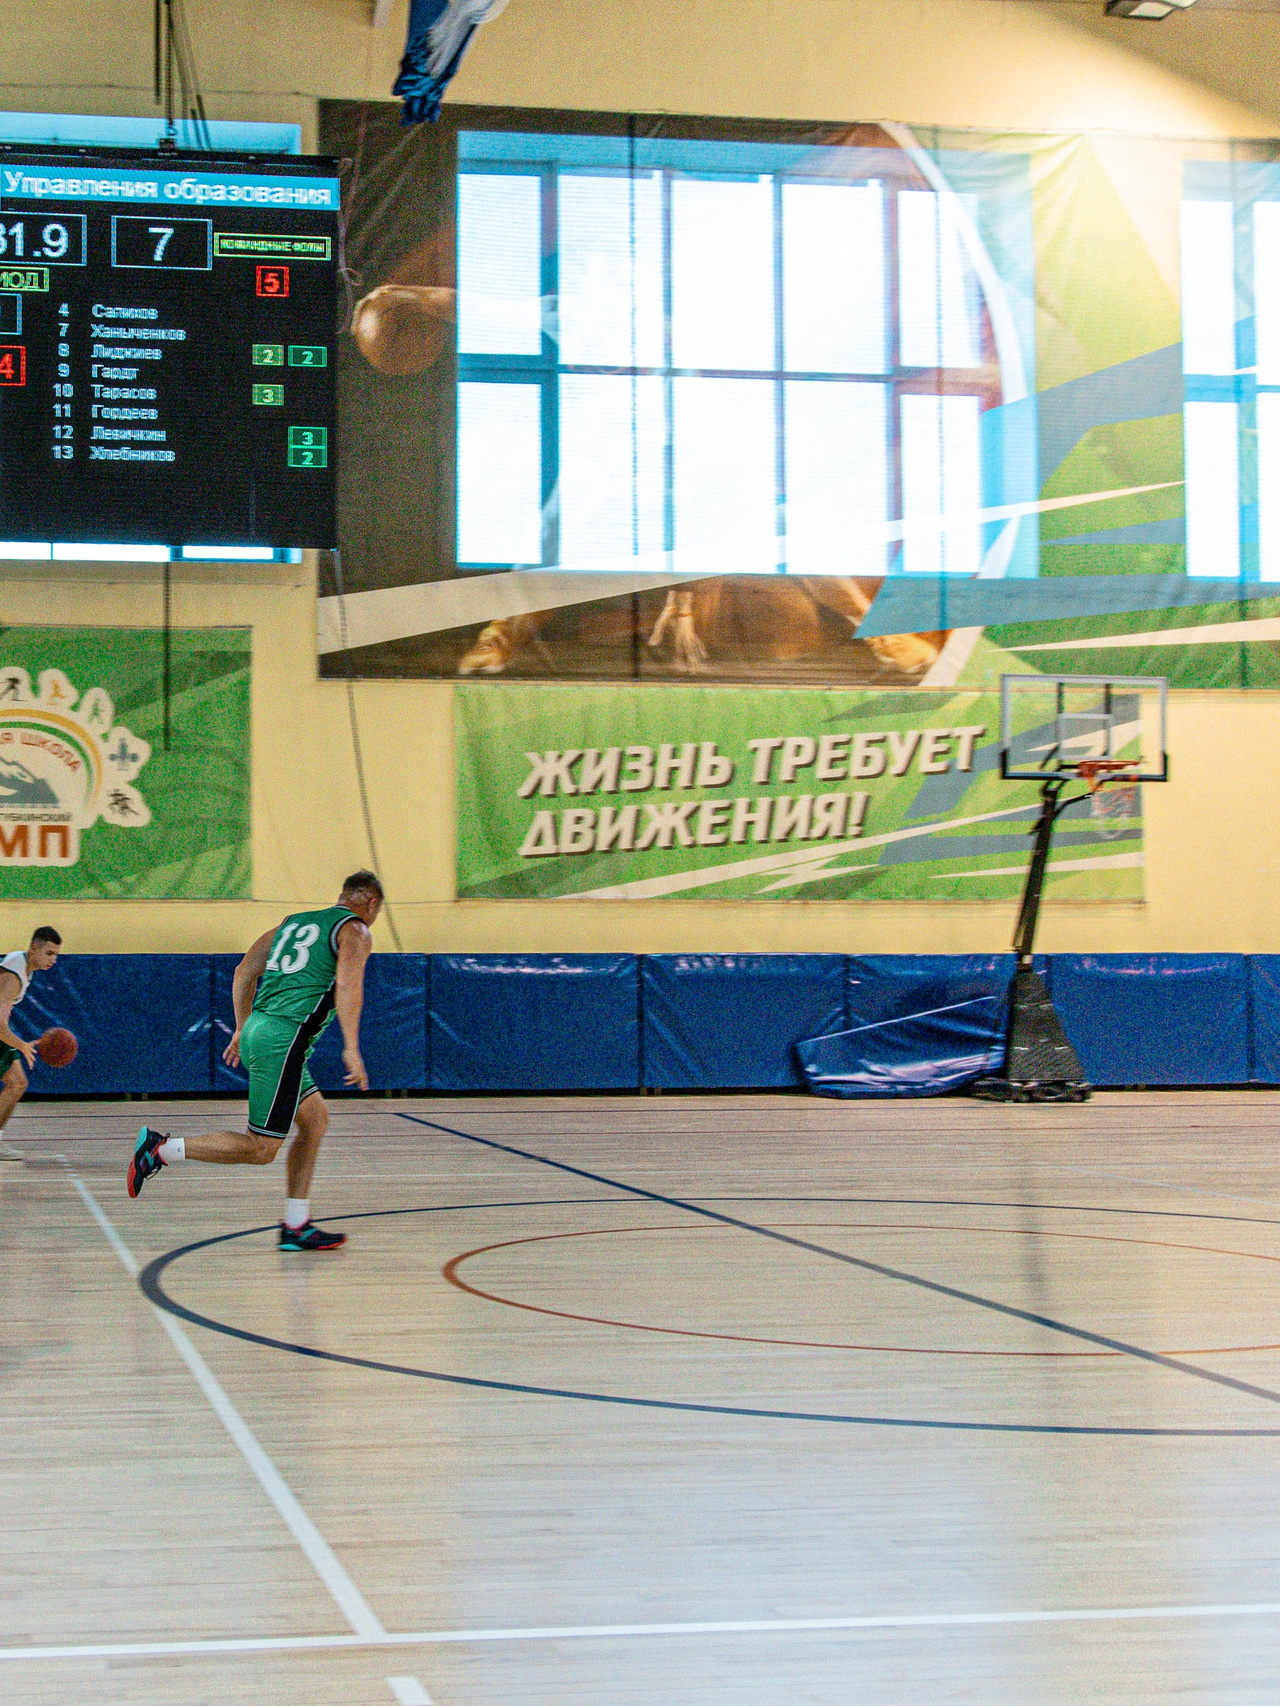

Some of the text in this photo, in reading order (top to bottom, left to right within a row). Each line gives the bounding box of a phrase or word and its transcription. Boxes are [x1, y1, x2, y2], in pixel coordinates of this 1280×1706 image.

[4, 170, 332, 205] Управления образования
[148, 228, 174, 262] 7
[264, 272, 280, 293] 5
[58, 303, 159, 320] 4 Салихов
[58, 322, 70, 337] 7
[262, 349, 274, 363] 2
[302, 351, 314, 365] 2
[58, 363, 70, 378] 9
[52, 383, 157, 400] 10 Тарасов
[262, 389, 274, 403] 3
[52, 403, 159, 420] 11 Гордеев
[52, 425, 74, 439] 12
[302, 431, 314, 445] 3
[51, 445, 176, 461] 13 Хлебников
[302, 451, 314, 465] 2
[19, 732, 82, 772] ШКОЛА
[518, 725, 986, 800] ЖИЗНЬ ТРЕБУЕТ
[518, 791, 871, 860] ДВИЖЕНИЯ!
[266, 923, 320, 974] 13
